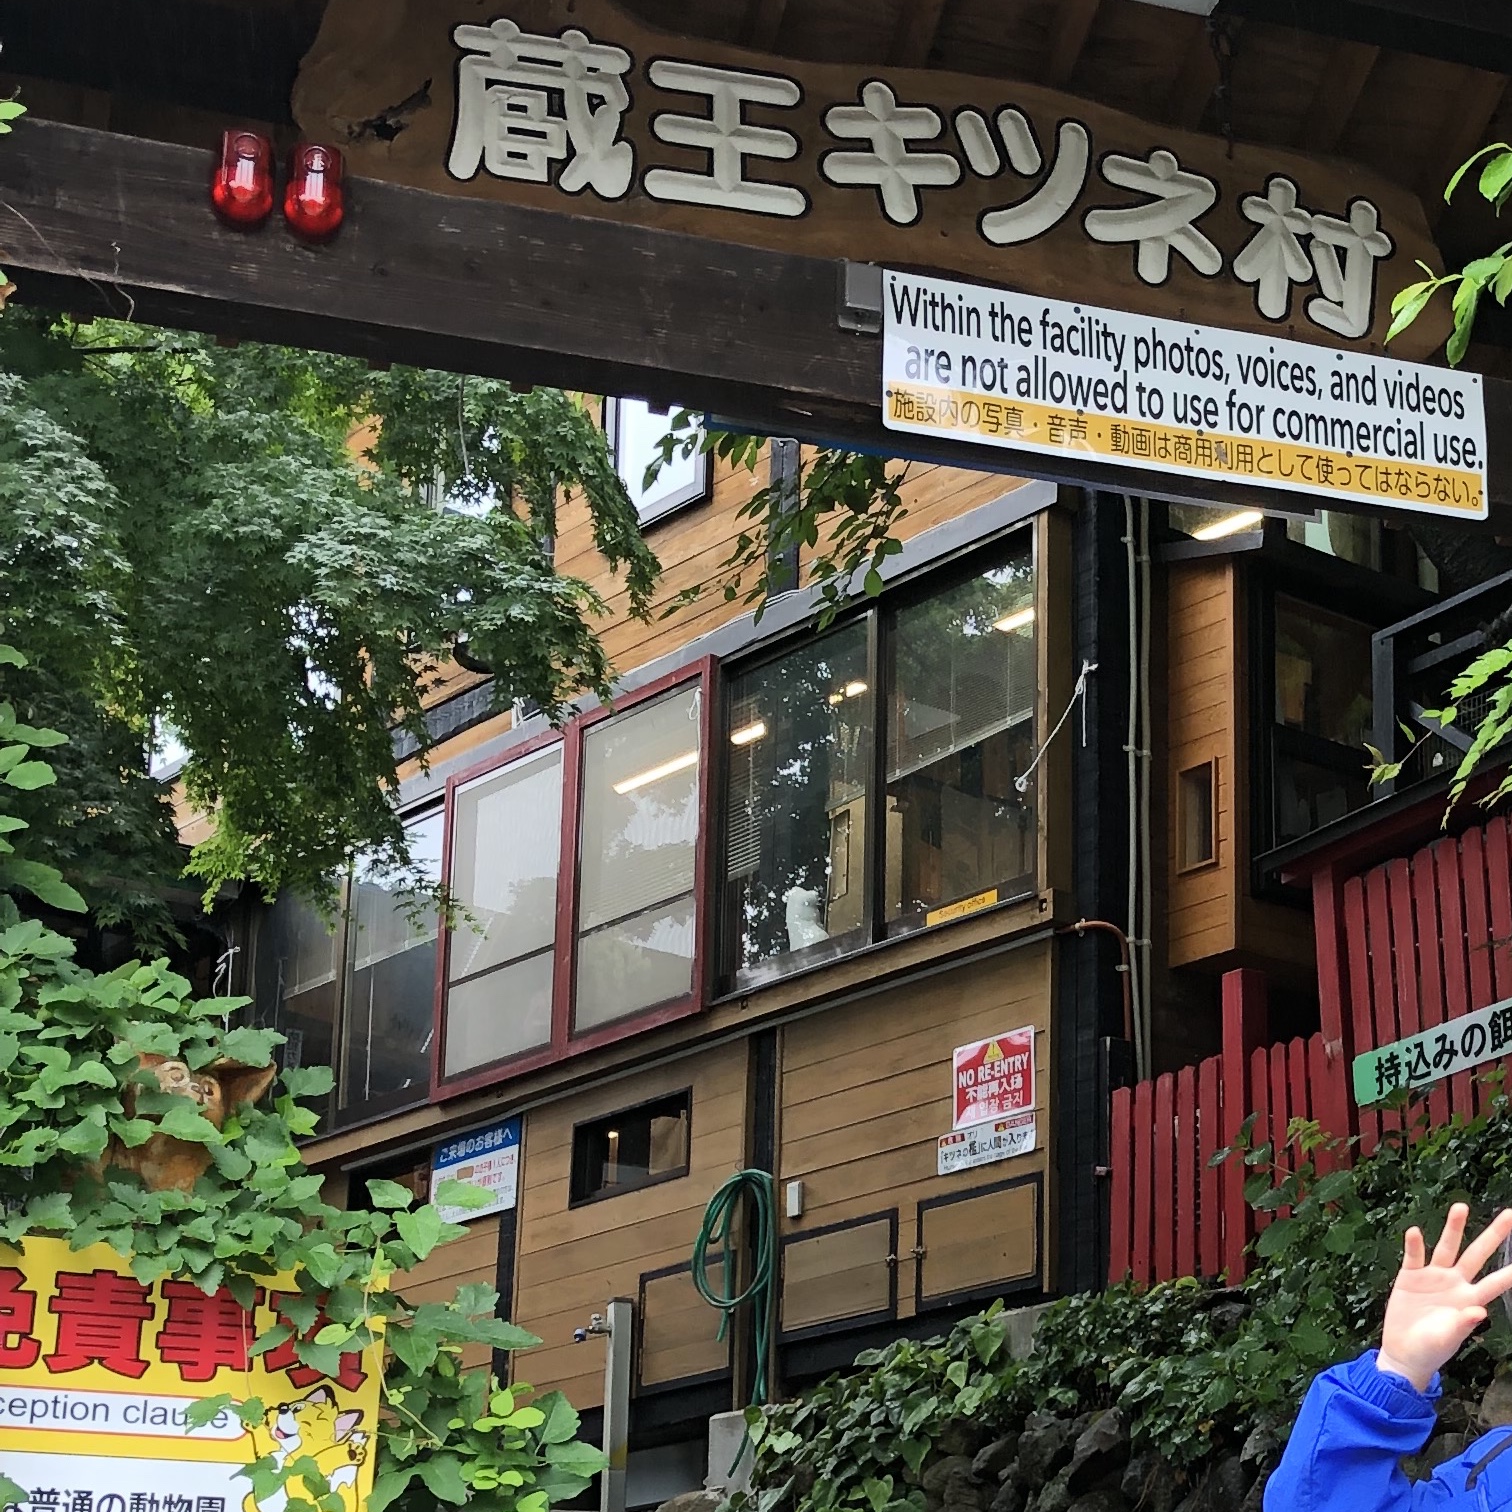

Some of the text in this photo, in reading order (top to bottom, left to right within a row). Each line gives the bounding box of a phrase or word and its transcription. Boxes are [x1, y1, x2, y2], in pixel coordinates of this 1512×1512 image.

[447, 17, 1393, 339] 蔵王キツネ村
[889, 281, 1466, 420] Within the facility photos, voices, and videos
[904, 344, 1484, 471] are not allowed to use for commercial use.
[958, 1051, 1030, 1089] NO RE-ENTRY
[1002, 1090, 1024, 1110] 금지
[0, 1395, 229, 1429] eption claue
